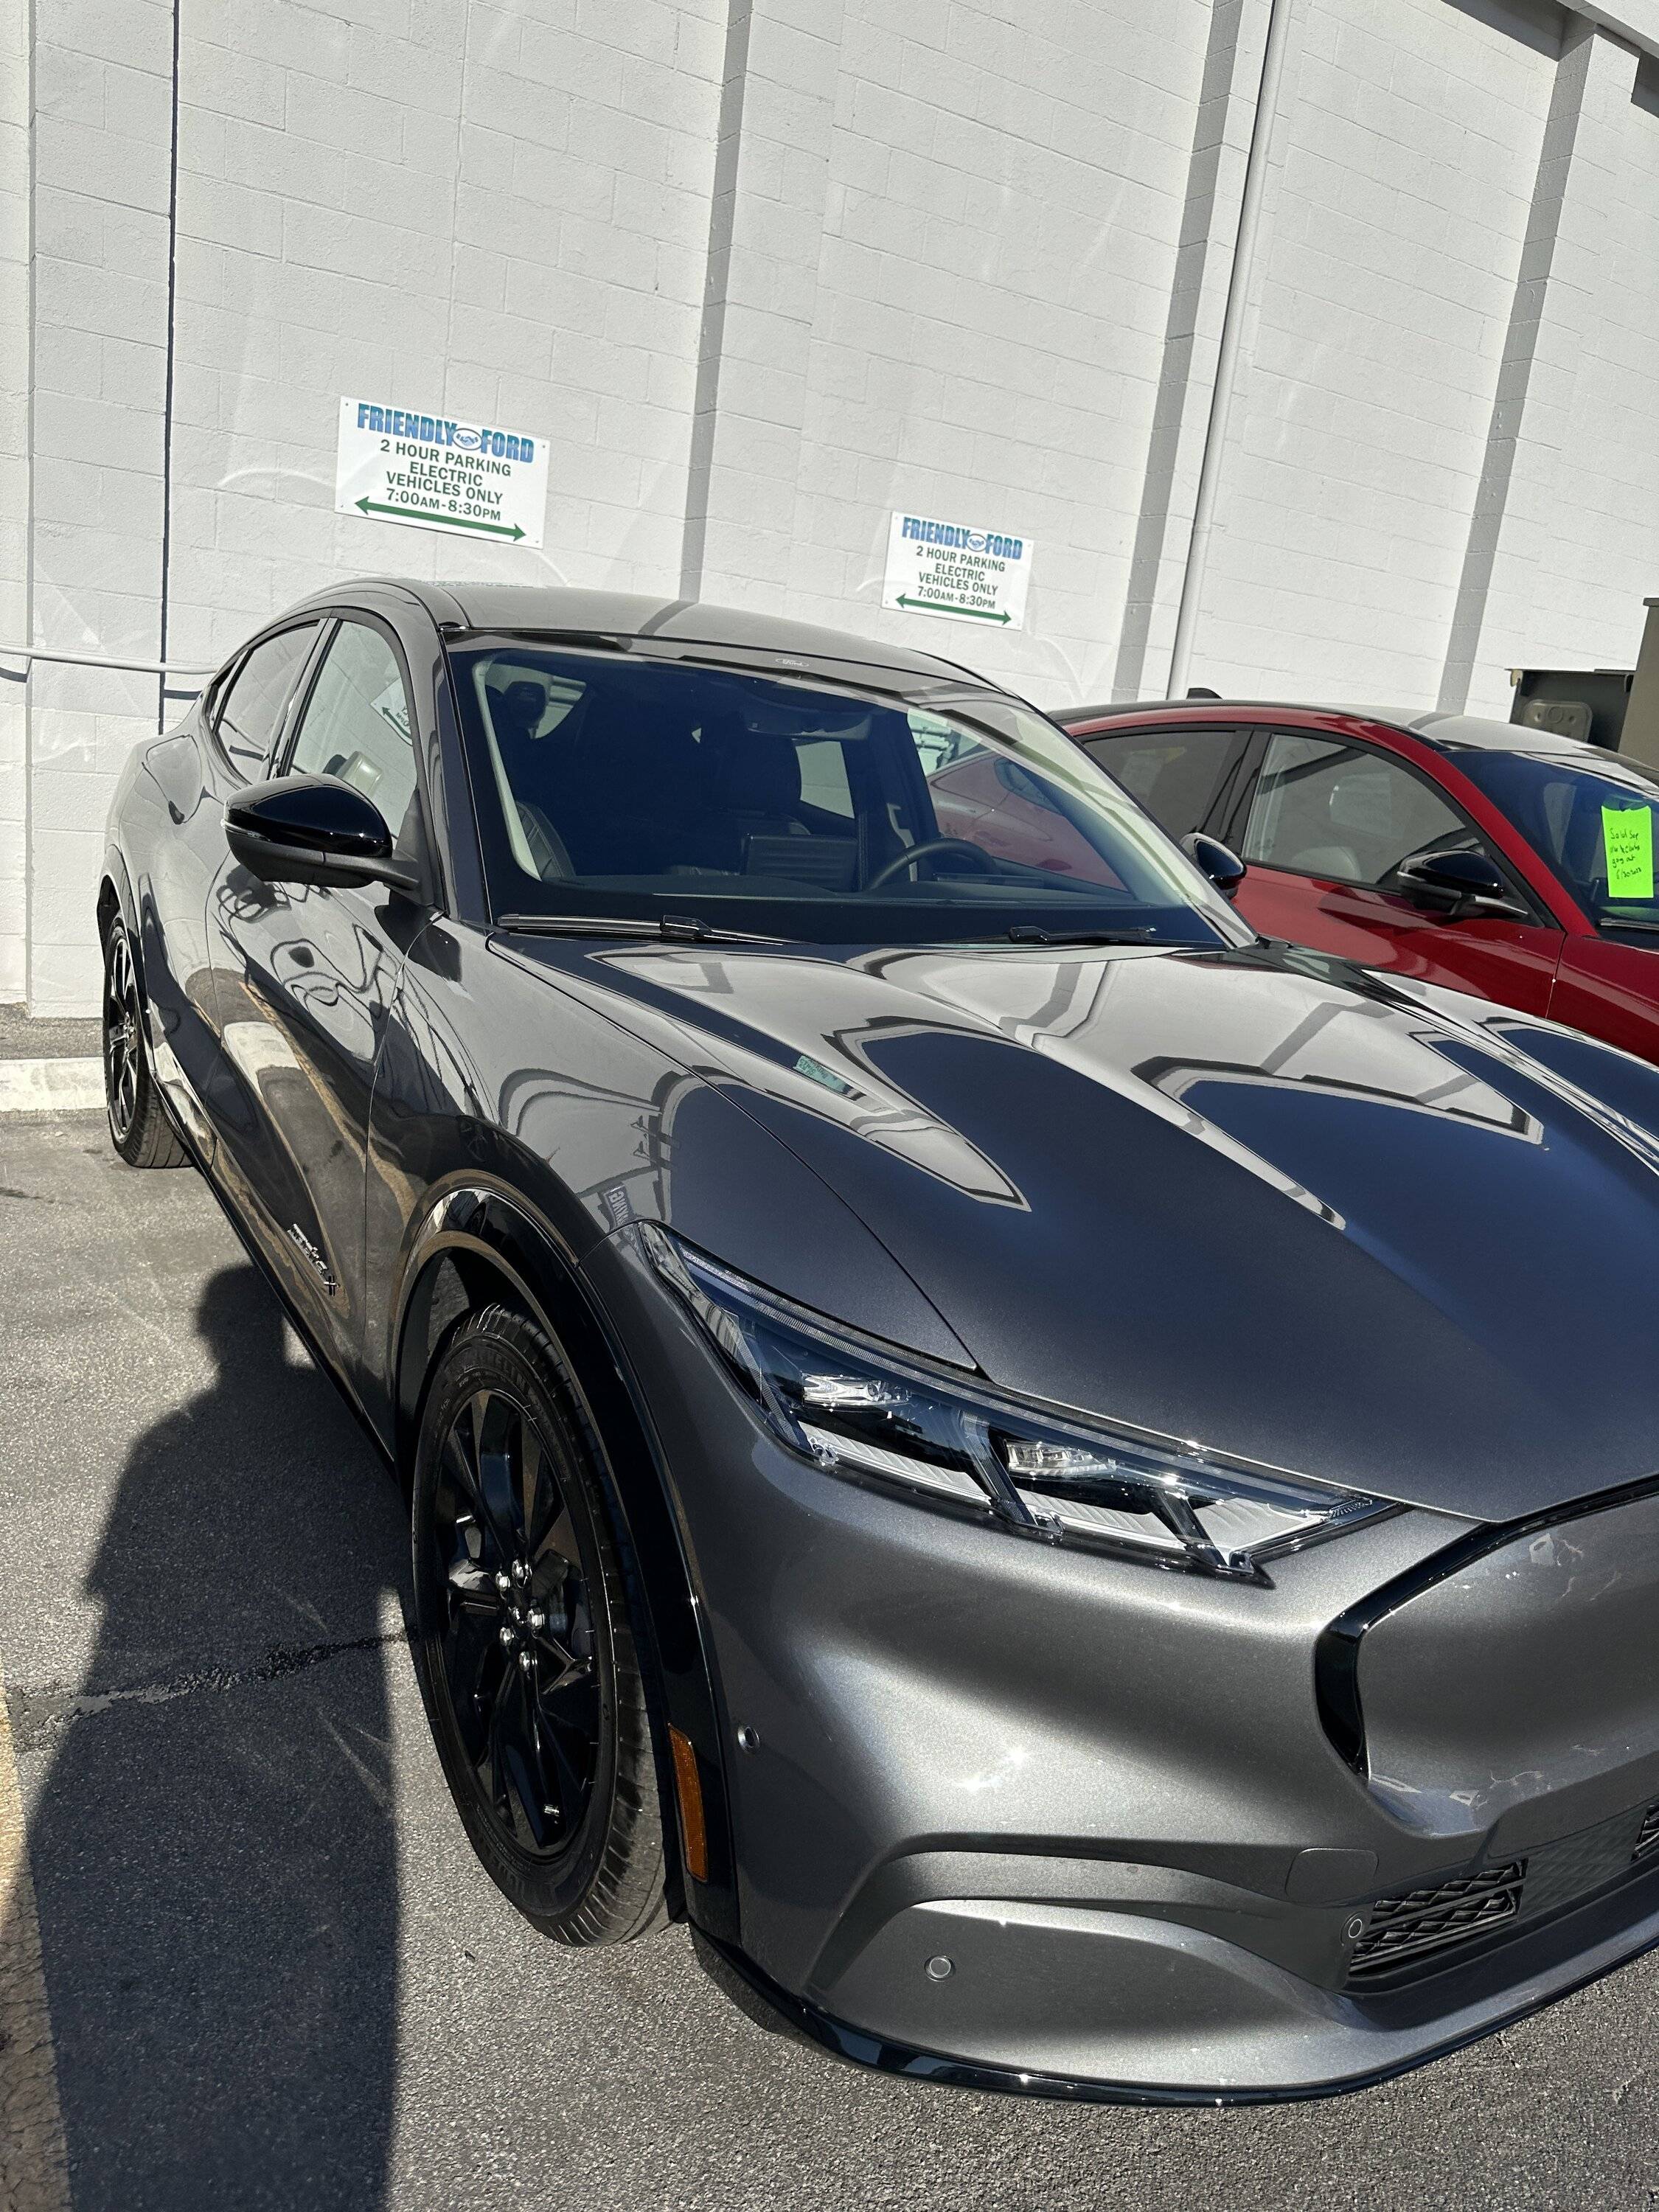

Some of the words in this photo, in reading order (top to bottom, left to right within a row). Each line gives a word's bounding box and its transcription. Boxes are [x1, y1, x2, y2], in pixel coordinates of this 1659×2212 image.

[357, 403, 458, 447] FRIENDLY
[480, 428, 535, 464] FORD
[380, 439, 391, 453] 2
[396, 442, 440, 463] HOUR
[445, 451, 512, 477] PARKING
[386, 471, 461, 497] VEHICLES
[466, 487, 503, 505] ONLY
[409, 461, 484, 487] ELECTRIC
[902, 516, 971, 549] FRIENDLY
[984, 533, 1023, 560] FORD
[916, 546, 924, 557] 2
[926, 547, 957, 563] HOUR
[960, 554, 1006, 572] PARKING
[935, 563, 985, 582] ELECTRIC
[919, 571, 970, 591] VEHICLES
[972, 582, 998, 596] ONLY
